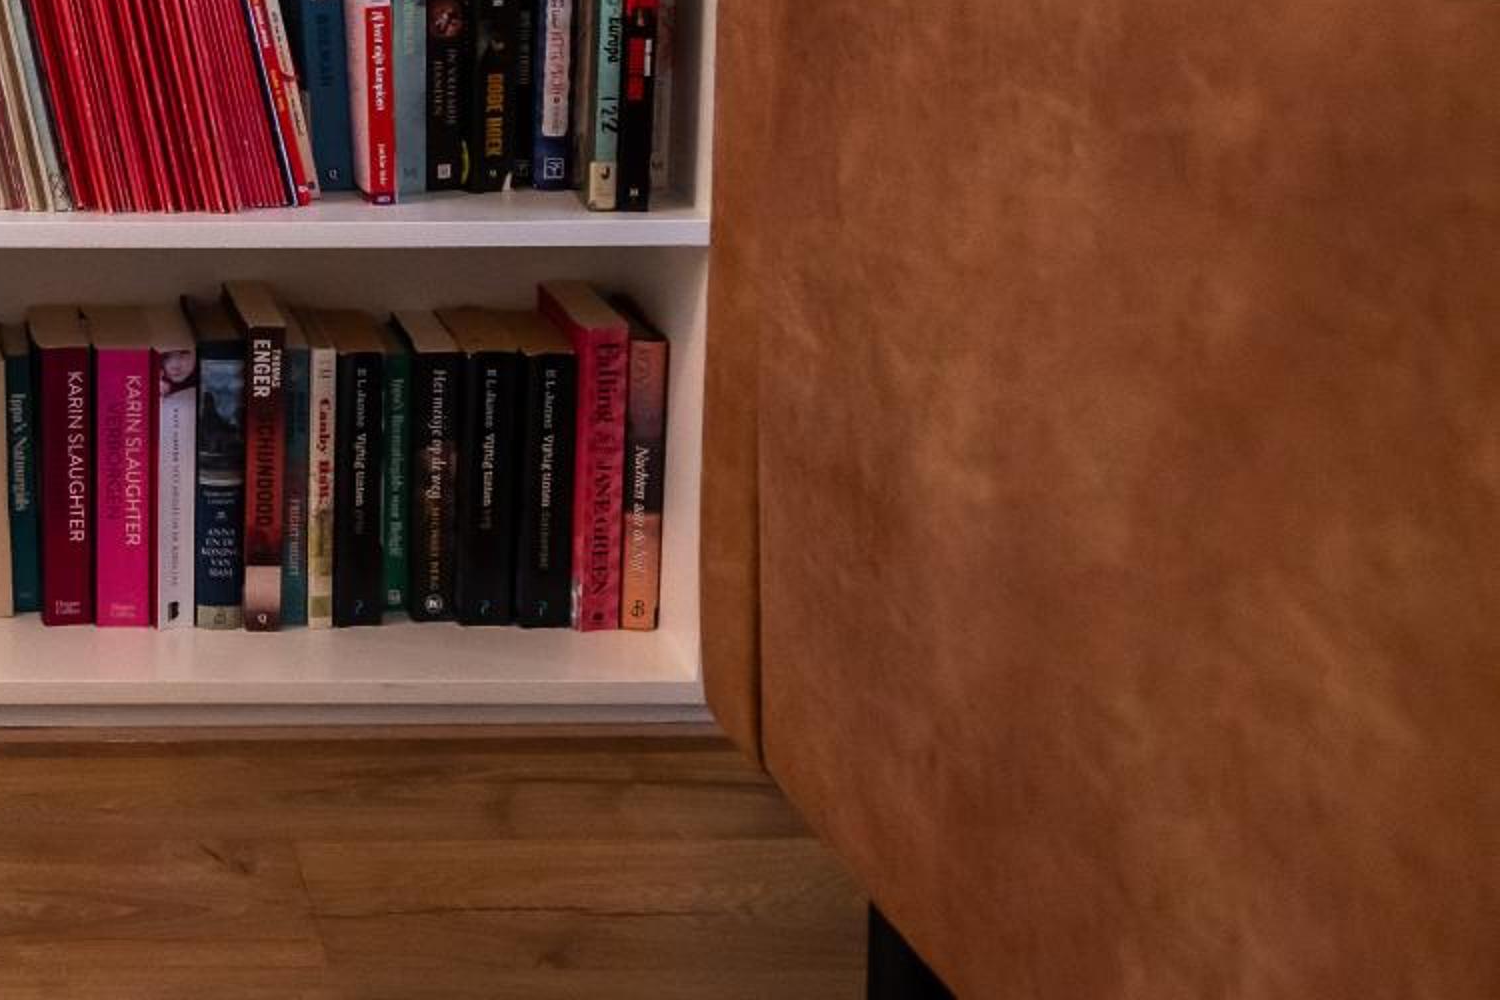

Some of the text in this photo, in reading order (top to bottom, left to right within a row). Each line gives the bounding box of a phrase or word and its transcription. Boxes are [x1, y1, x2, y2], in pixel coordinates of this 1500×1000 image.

[605, 16, 622, 64] Europa
[253, 338, 272, 399] ENGER
[432, 368, 446, 394] Het
[595, 342, 619, 423] Falling
[428, 396, 445, 435] meisje
[67, 371, 85, 541] KARIN SLAUGHTER
[105, 403, 120, 519] VERBORGEN
[126, 375, 142, 545] KARIN SLAUGHTER
[425, 474, 441, 499] weg
[430, 456, 445, 472] de
[590, 464, 610, 596] JANE GREEN
